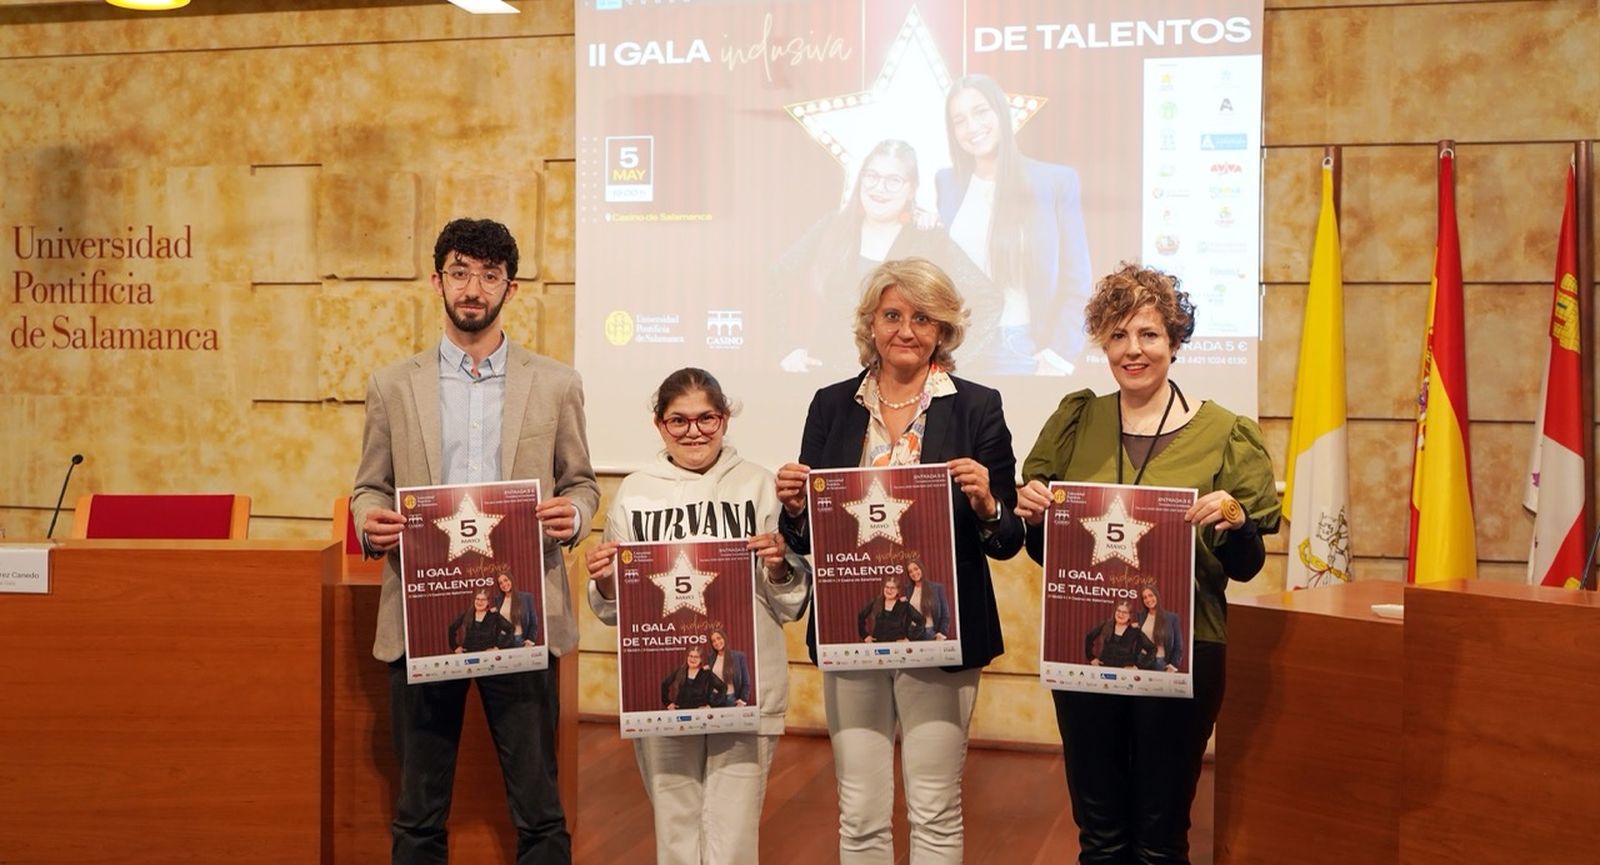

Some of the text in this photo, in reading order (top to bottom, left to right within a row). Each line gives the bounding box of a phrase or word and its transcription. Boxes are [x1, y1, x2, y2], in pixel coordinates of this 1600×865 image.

[974, 16, 1252, 52] DE TALENTOS
[588, 44, 606, 66] II
[614, 39, 712, 66] GALA
[619, 147, 639, 168] 5
[612, 169, 646, 181] MAY
[613, 212, 713, 222] Casino de Salamanca
[12, 224, 193, 260] Universidad
[12, 269, 155, 304] Pontificia
[636, 314, 680, 324] Universidad
[10, 315, 219, 350] de Salamanca
[636, 324, 670, 334] Pontificia
[706, 336, 743, 346] CASINO
[1225, 341, 1234, 351] 5
[632, 500, 756, 541] NIRVANA
[870, 504, 886, 522] 5
[460, 520, 477, 537] 5
[1107, 523, 1124, 542] 5
[827, 554, 833, 562] II
[836, 553, 870, 562] GALA
[417, 570, 424, 578] II
[426, 567, 461, 577] GALA
[818, 566, 903, 577] DE TALENTOS
[1059, 569, 1065, 578] II
[1068, 570, 1104, 581] GALA
[408, 577, 494, 592] DE TALENTOS
[675, 576, 691, 593] 5
[1048, 583, 1065, 593] DE
[1069, 584, 1138, 598] TALENTOS
[632, 624, 638, 632] II
[642, 623, 675, 631] GALA
[623, 635, 707, 646] DE TALENTOS
